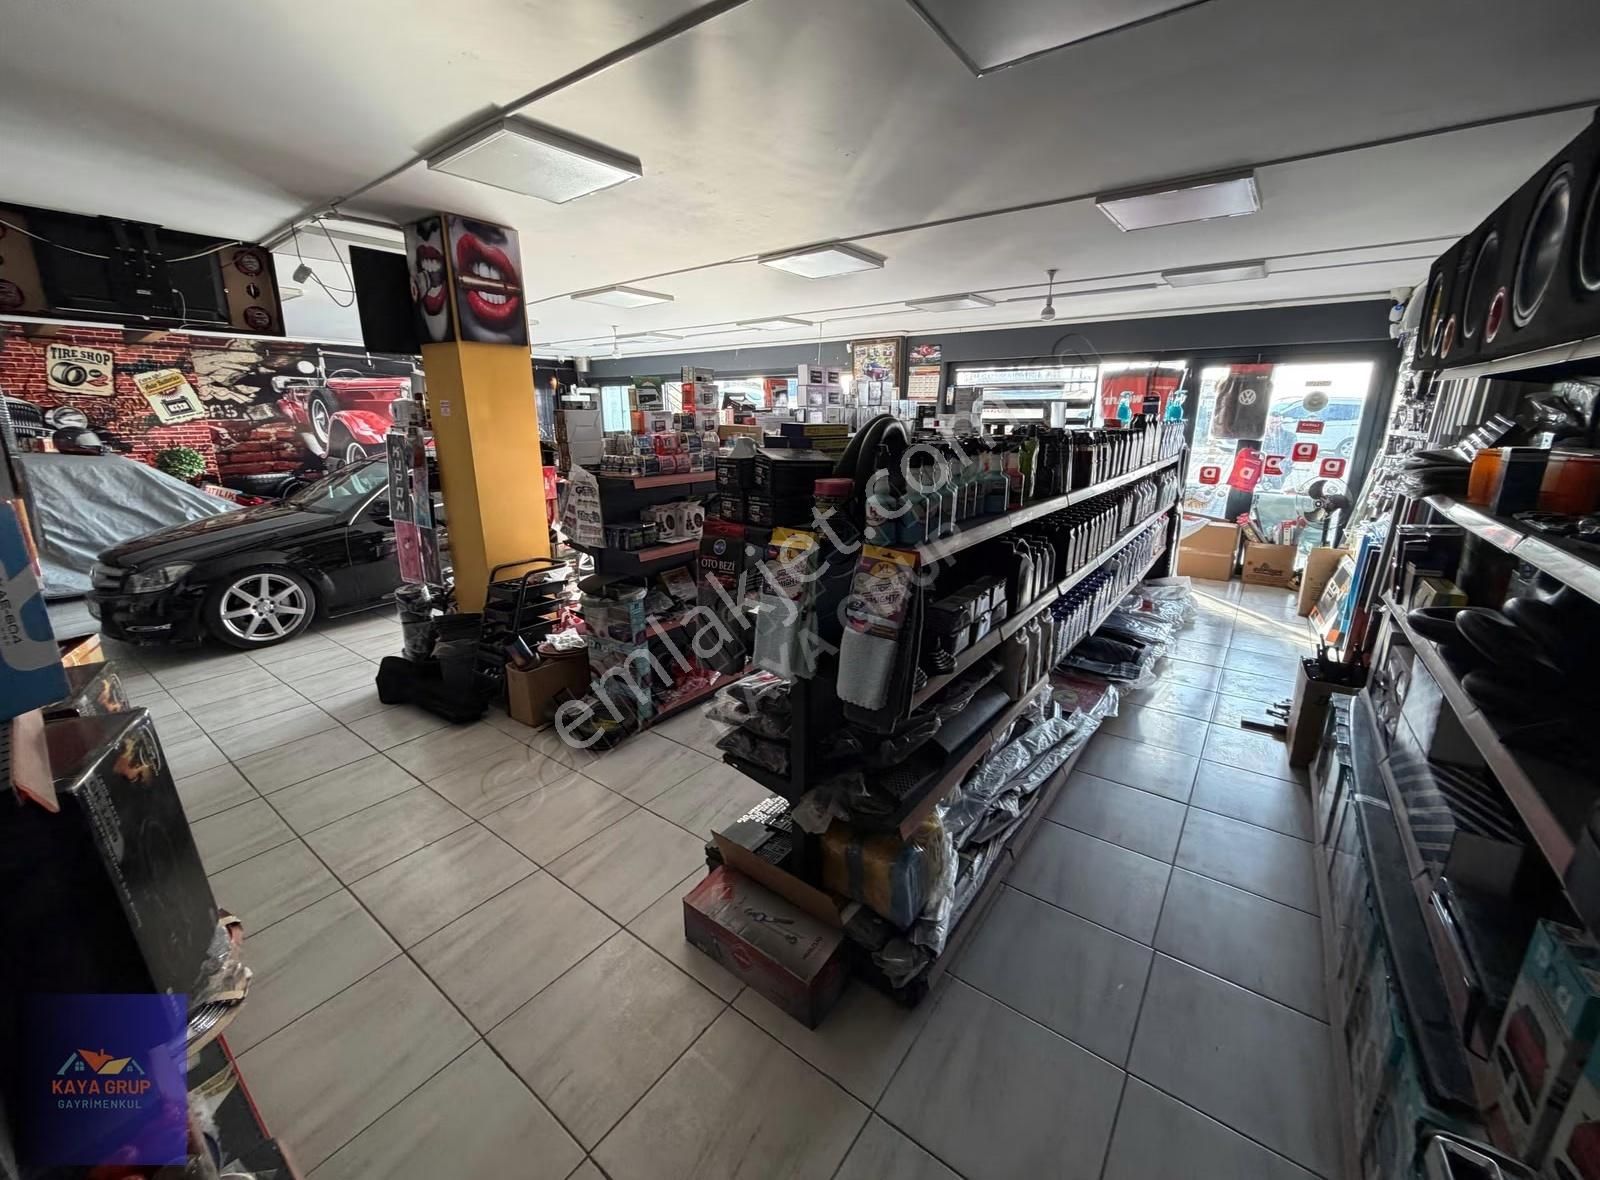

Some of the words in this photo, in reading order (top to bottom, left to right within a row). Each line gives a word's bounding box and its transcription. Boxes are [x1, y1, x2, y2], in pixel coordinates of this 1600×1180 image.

[51, 347, 78, 359] TIRE
[80, 351, 110, 365] SHOP
[392, 446, 405, 512] KUPON
[701, 558, 719, 569] OTO
